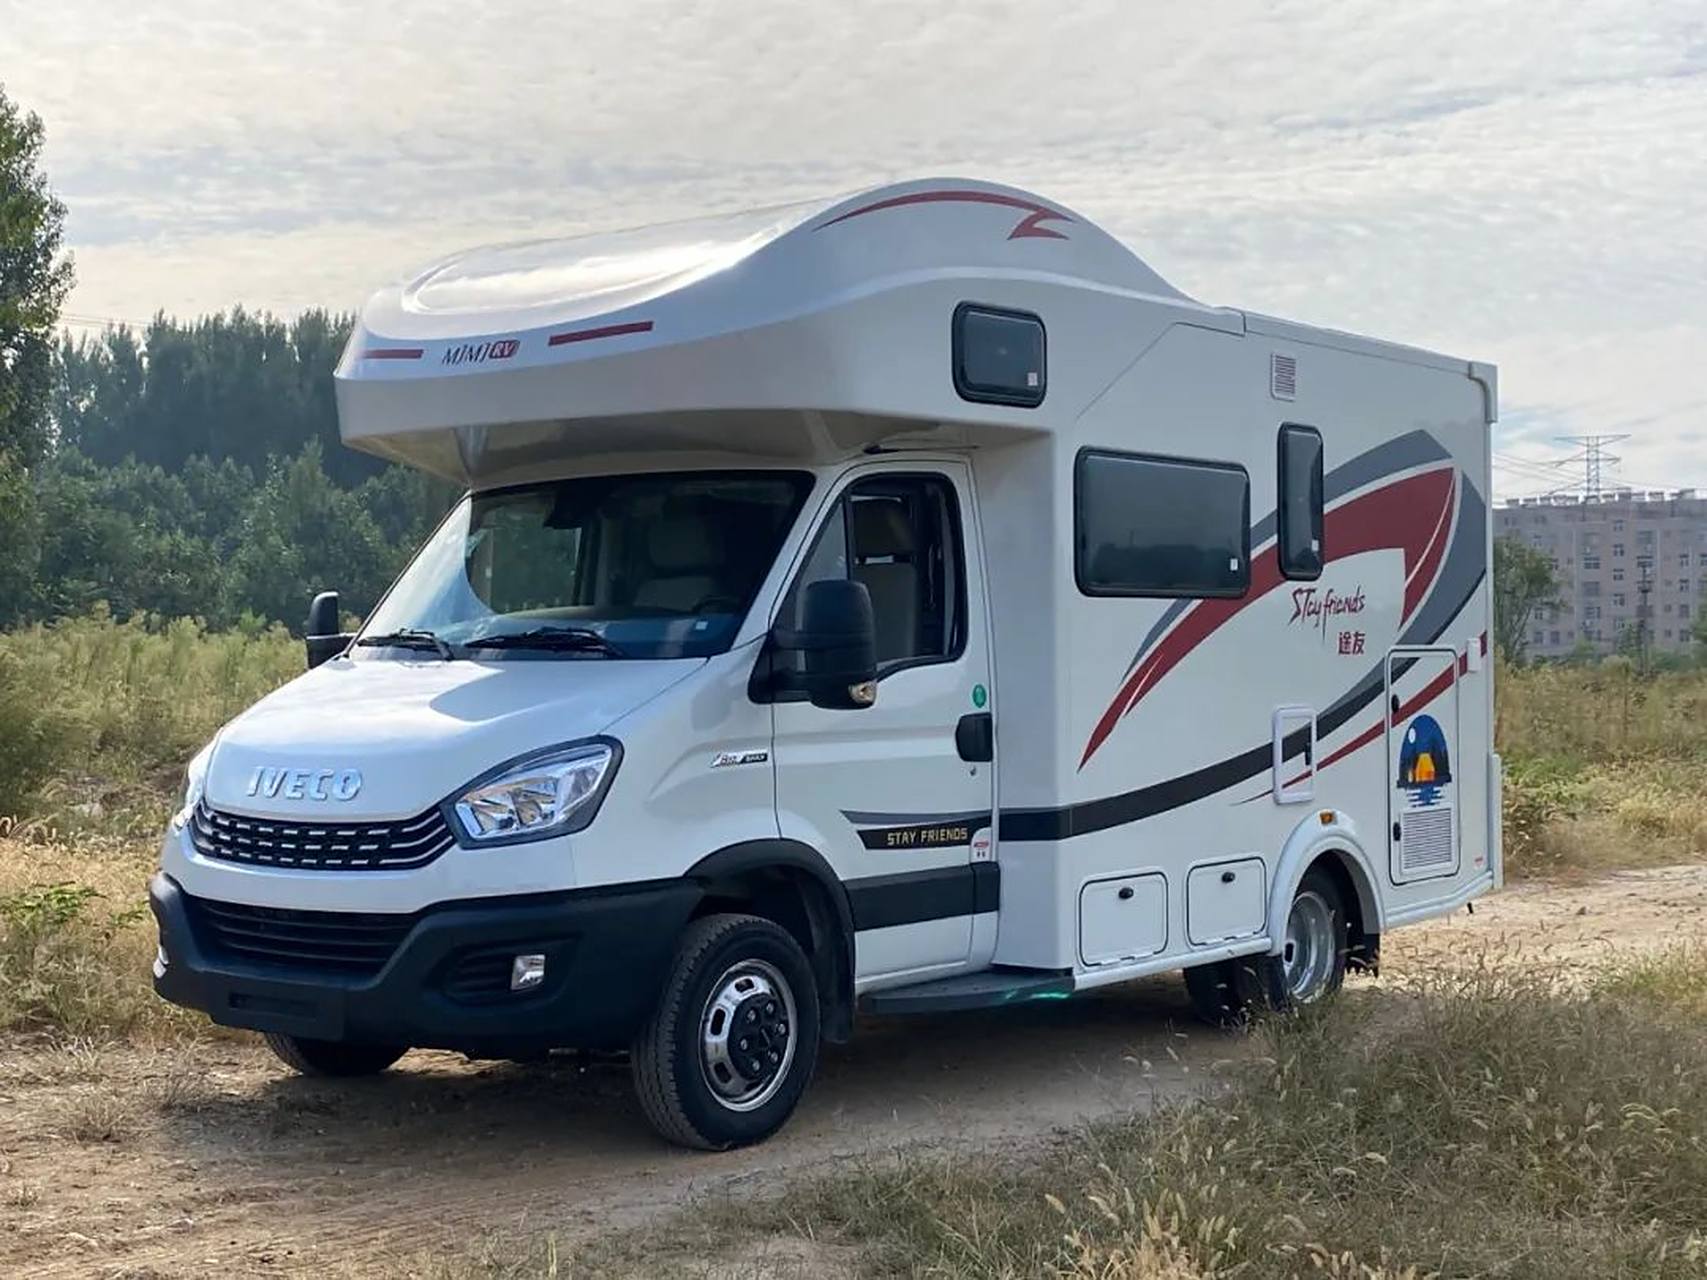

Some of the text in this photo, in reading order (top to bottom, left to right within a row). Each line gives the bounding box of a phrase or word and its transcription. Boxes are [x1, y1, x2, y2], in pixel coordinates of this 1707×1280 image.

[1339, 631, 1365, 655] 途友
[246, 767, 363, 801] IVECO
[887, 827, 968, 846] STAY FRIENDS
